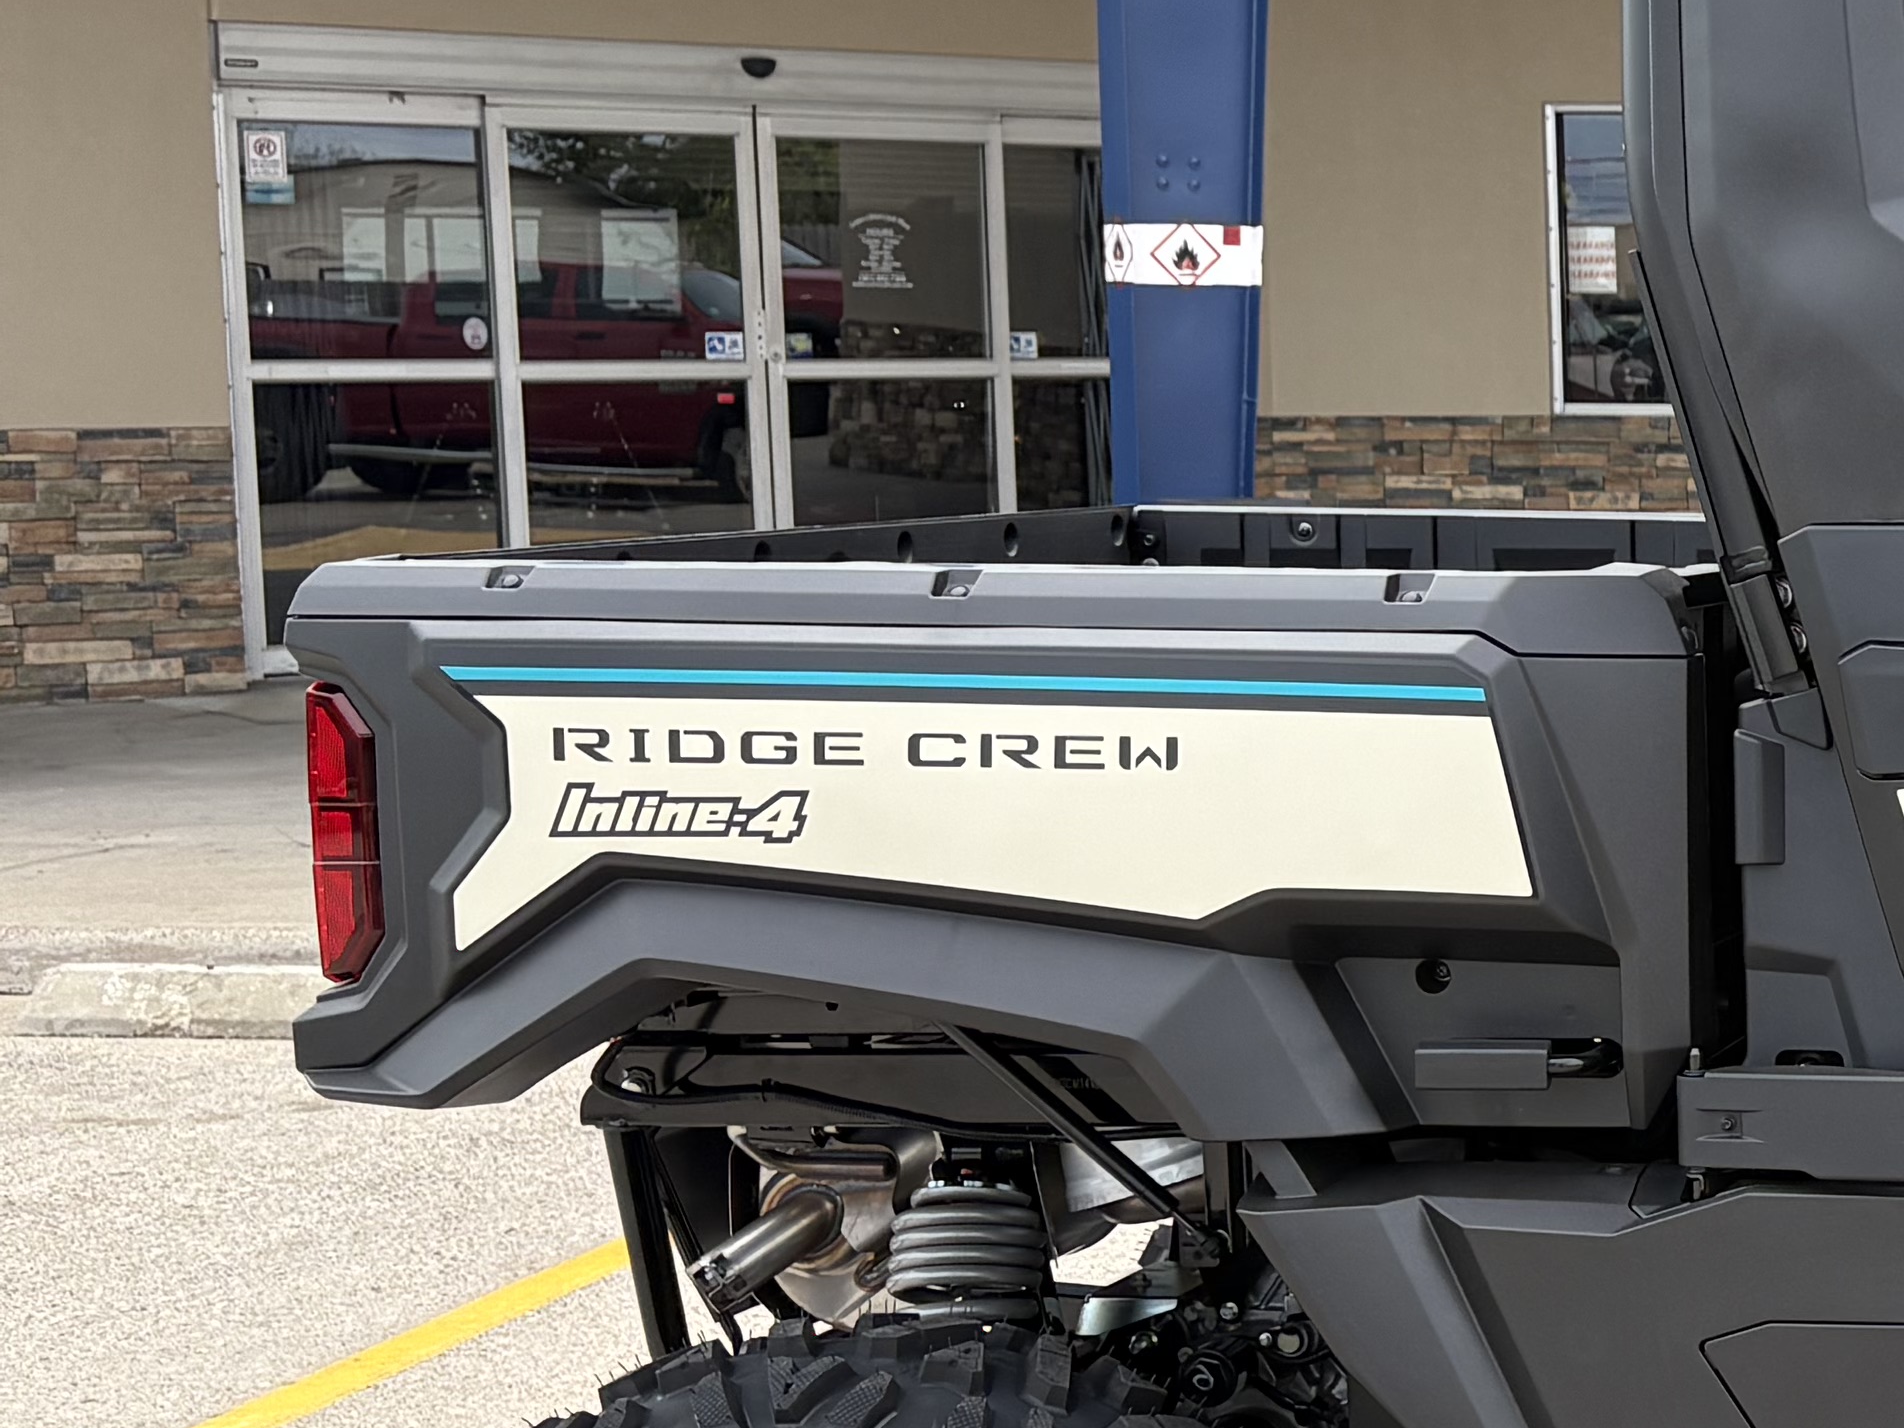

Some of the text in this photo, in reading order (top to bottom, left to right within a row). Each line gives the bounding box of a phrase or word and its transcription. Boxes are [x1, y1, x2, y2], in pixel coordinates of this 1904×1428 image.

[553, 727, 1178, 771] RIDGE CREW
[549, 782, 809, 843] Inline-4
